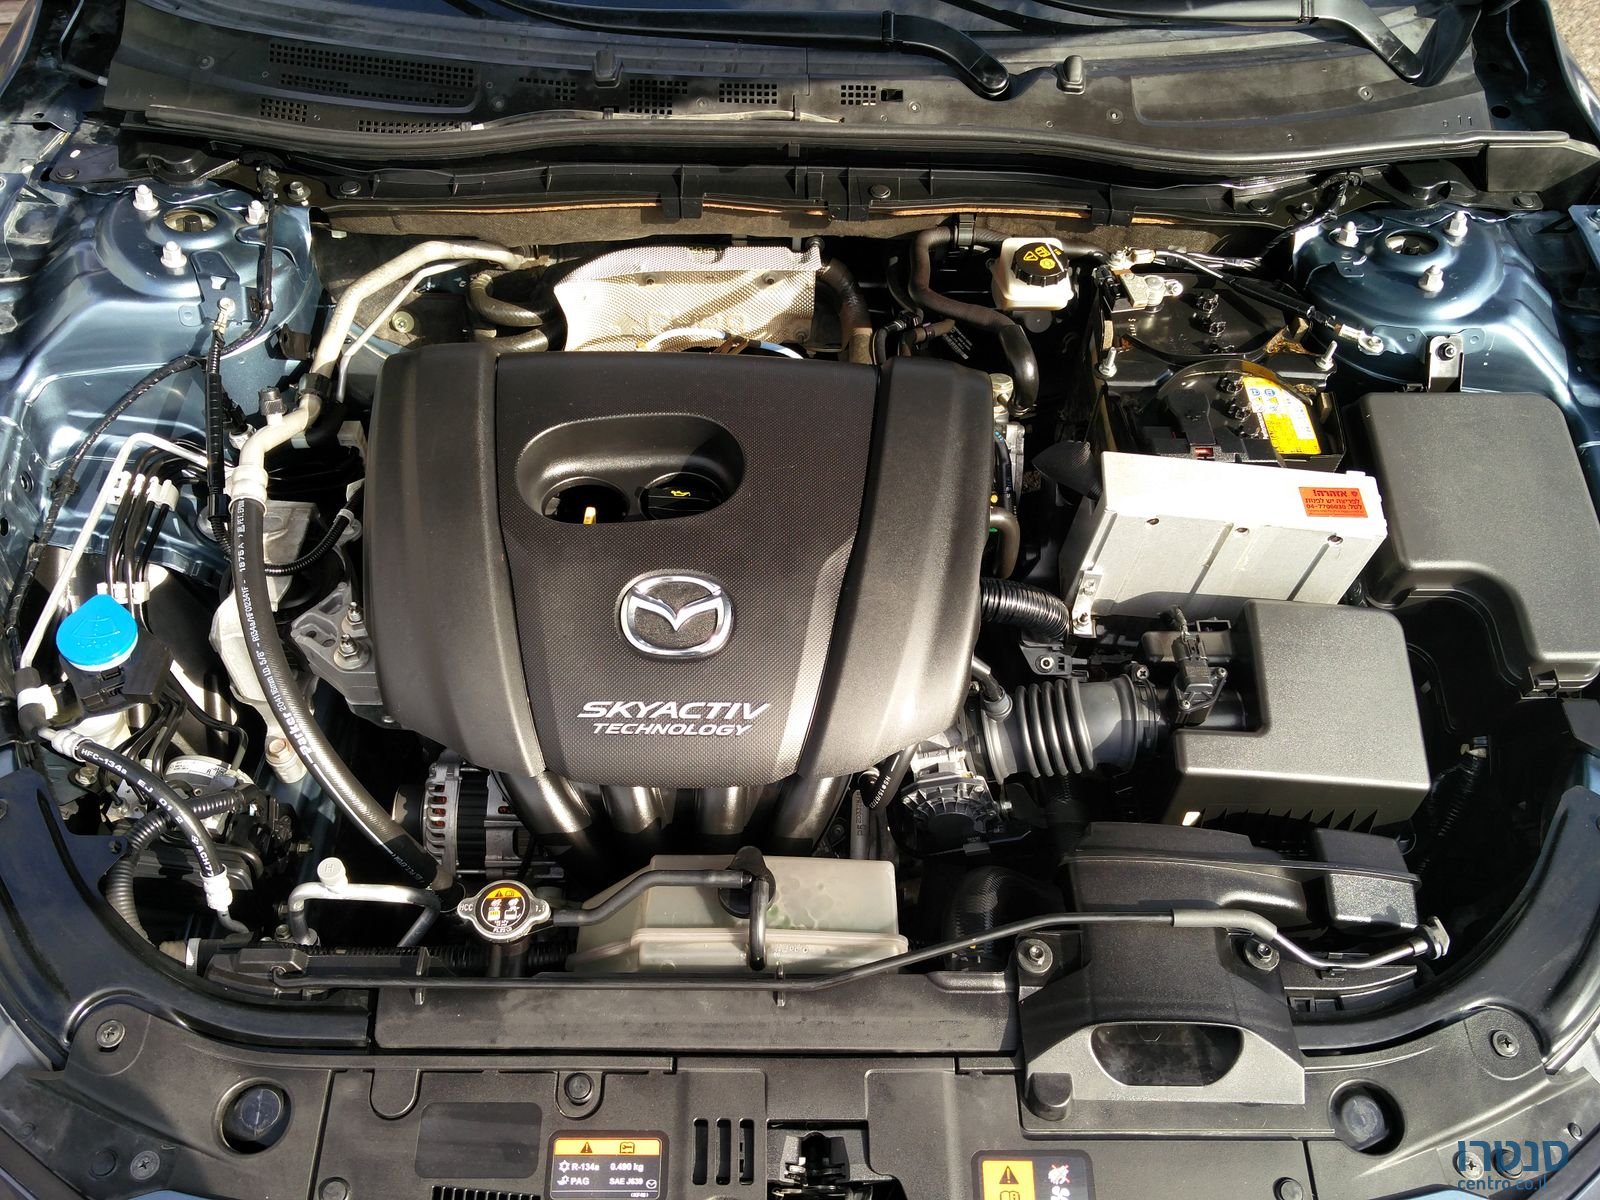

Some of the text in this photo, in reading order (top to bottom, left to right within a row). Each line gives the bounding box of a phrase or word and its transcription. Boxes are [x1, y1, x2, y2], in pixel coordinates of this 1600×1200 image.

[577, 701, 770, 719] SKYACTIV
[283, 711, 313, 756] Parker
[593, 722, 752, 736] TECHNOLOGY
[81, 749, 128, 775] HFC-134a
[137, 779, 154, 793] EJ
[325, 863, 335, 873] H
[460, 903, 474, 912] HCC
[571, 1162, 600, 1171] R-134a
[633, 1162, 644, 1173] kg
[570, 1177, 590, 1185] PAG
[609, 1177, 625, 1185] SAE
